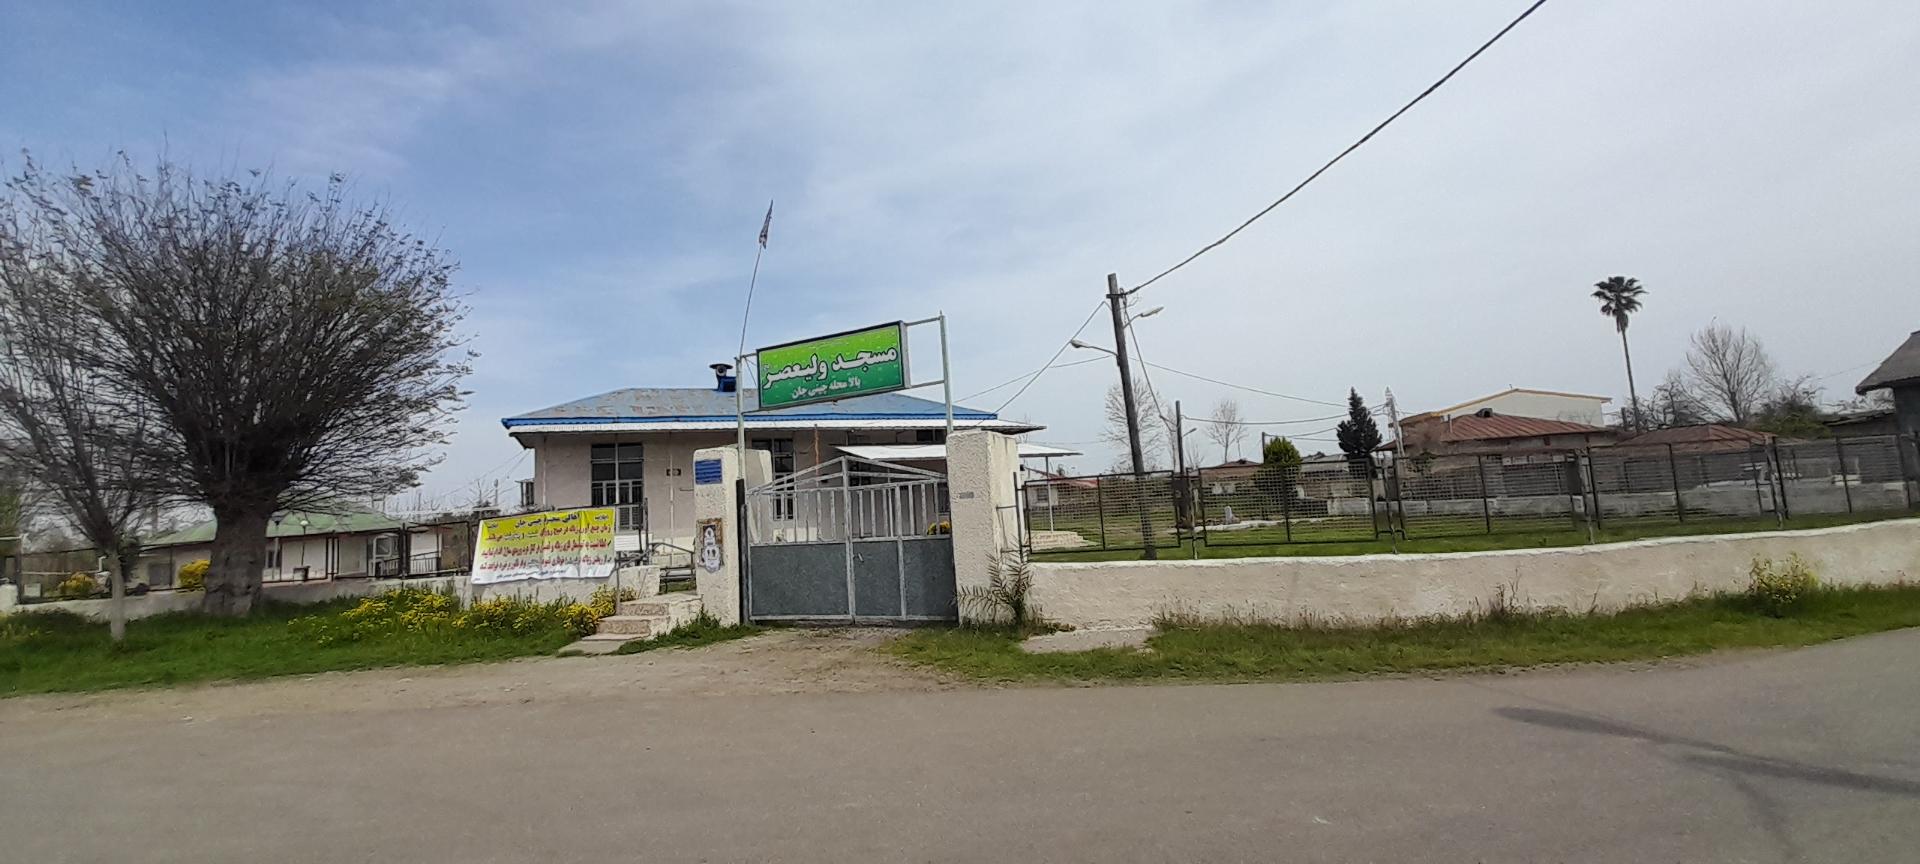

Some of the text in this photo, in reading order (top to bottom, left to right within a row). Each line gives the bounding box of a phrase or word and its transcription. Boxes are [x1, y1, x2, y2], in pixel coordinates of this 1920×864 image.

[832, 346, 897, 372] مسجد
[830, 380, 848, 390] محله
[848, 375, 861, 388] بالا
